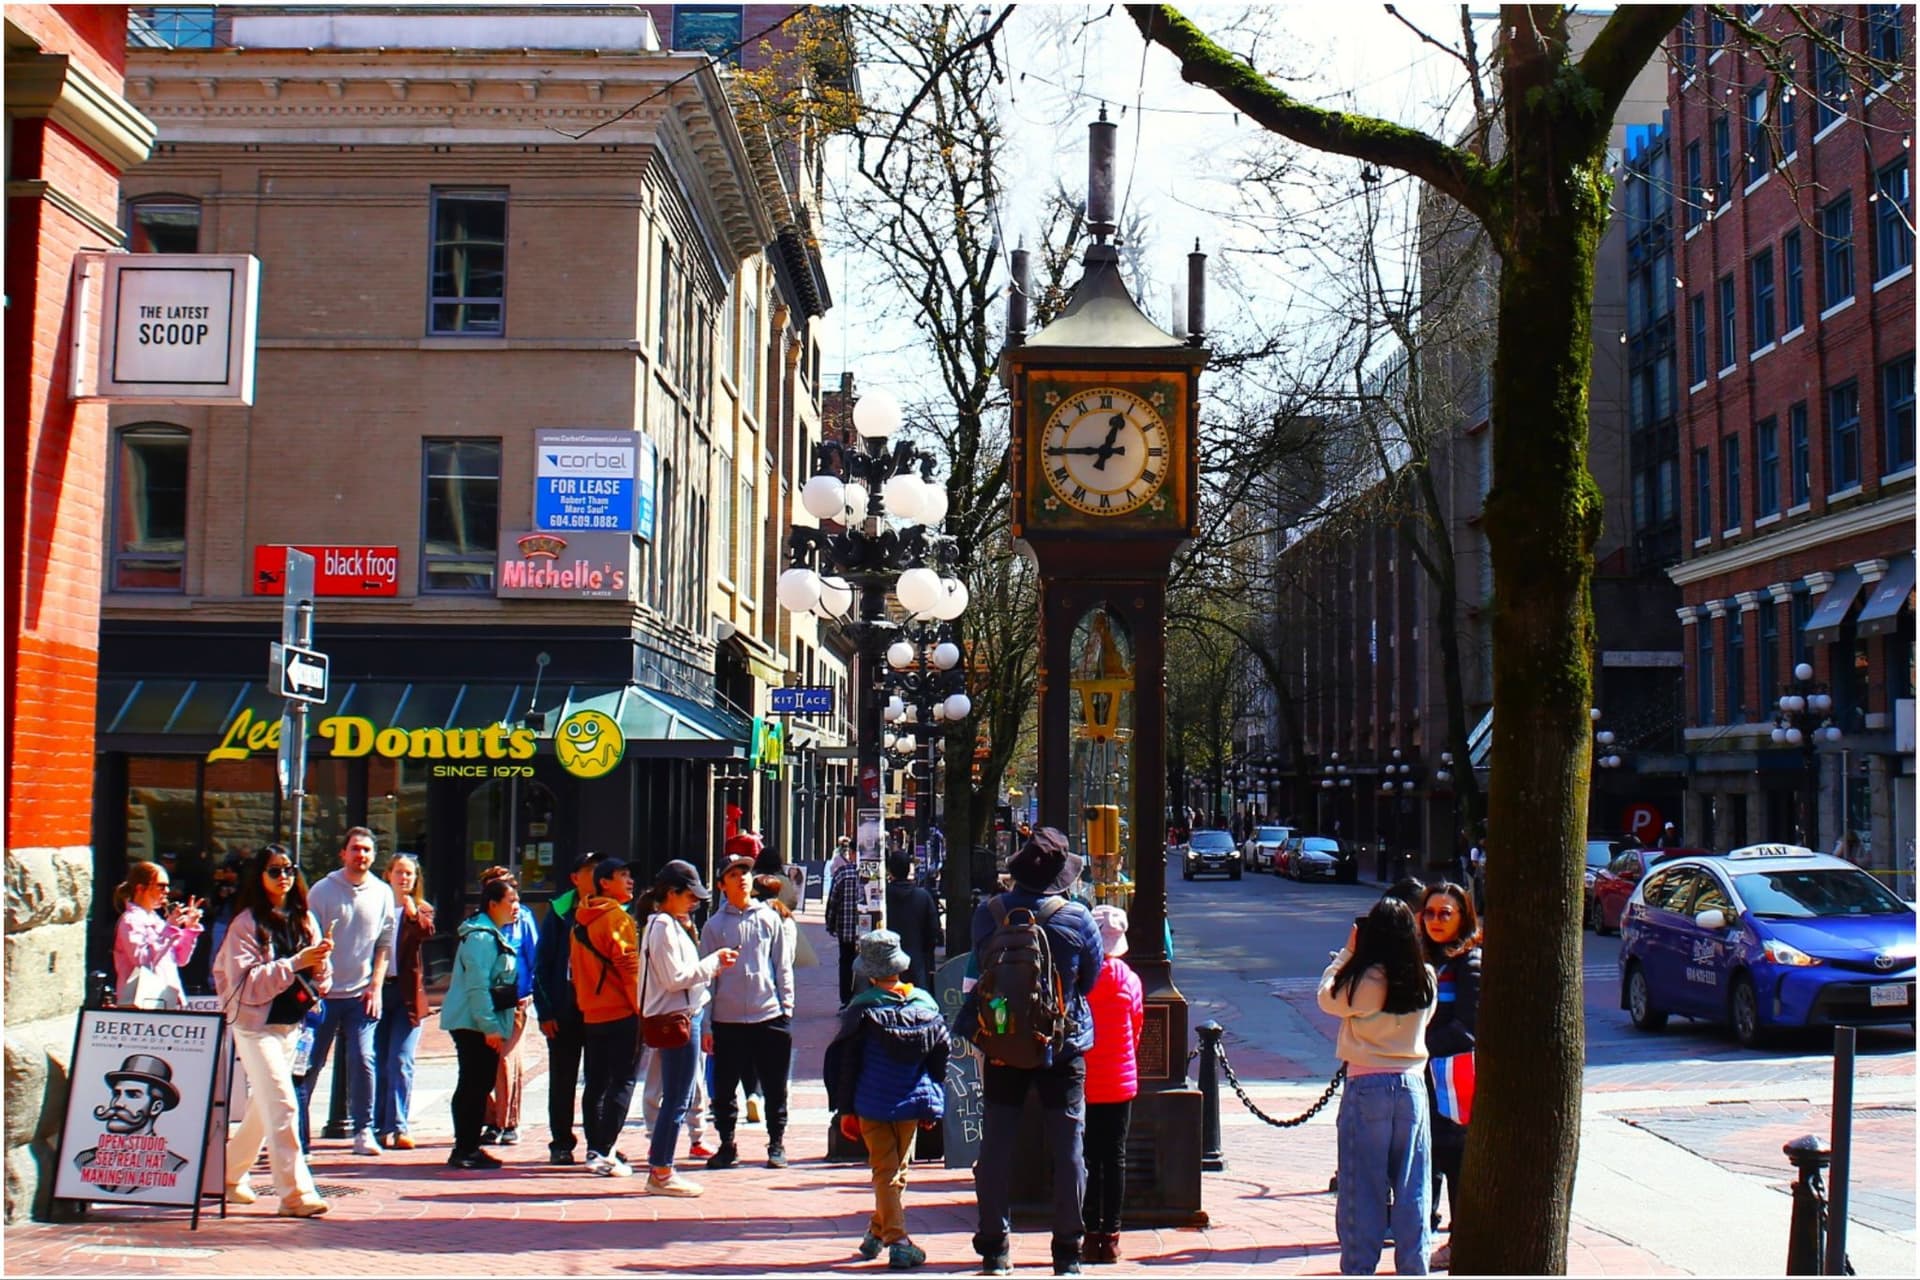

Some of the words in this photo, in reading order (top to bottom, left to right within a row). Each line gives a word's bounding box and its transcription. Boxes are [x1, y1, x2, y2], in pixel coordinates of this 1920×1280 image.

[140, 305, 163, 319] THE
[167, 306, 209, 319] LATEST
[138, 323, 209, 346] SCOOP
[560, 452, 627, 469] corbel
[551, 479, 577, 494] FOR
[580, 479, 620, 495] LEASE
[560, 495, 586, 505] Robert
[588, 496, 609, 505] Tham
[565, 505, 585, 514] Marc
[324, 549, 363, 576] black
[366, 550, 396, 583] frog
[502, 559, 625, 590] Michelle's
[773, 696, 793, 705] KIT
[806, 696, 827, 705] ACE
[318, 715, 538, 760] Donuts
[433, 766, 487, 778] SINCE
[493, 766, 535, 778] 1979
[1632, 809, 1652, 832] P
[1756, 847, 1788, 856] TAXI
[95, 1020, 208, 1040] BERTACCHI
[98, 1133, 125, 1149] OPEN
[95, 1151, 114, 1166] SEE
[116, 1152, 141, 1168] REAL
[144, 1154, 166, 1168] HAT
[80, 1168, 122, 1183] MAKING
[122, 1170, 136, 1184] IN
[138, 1171, 177, 1187] ACTION
